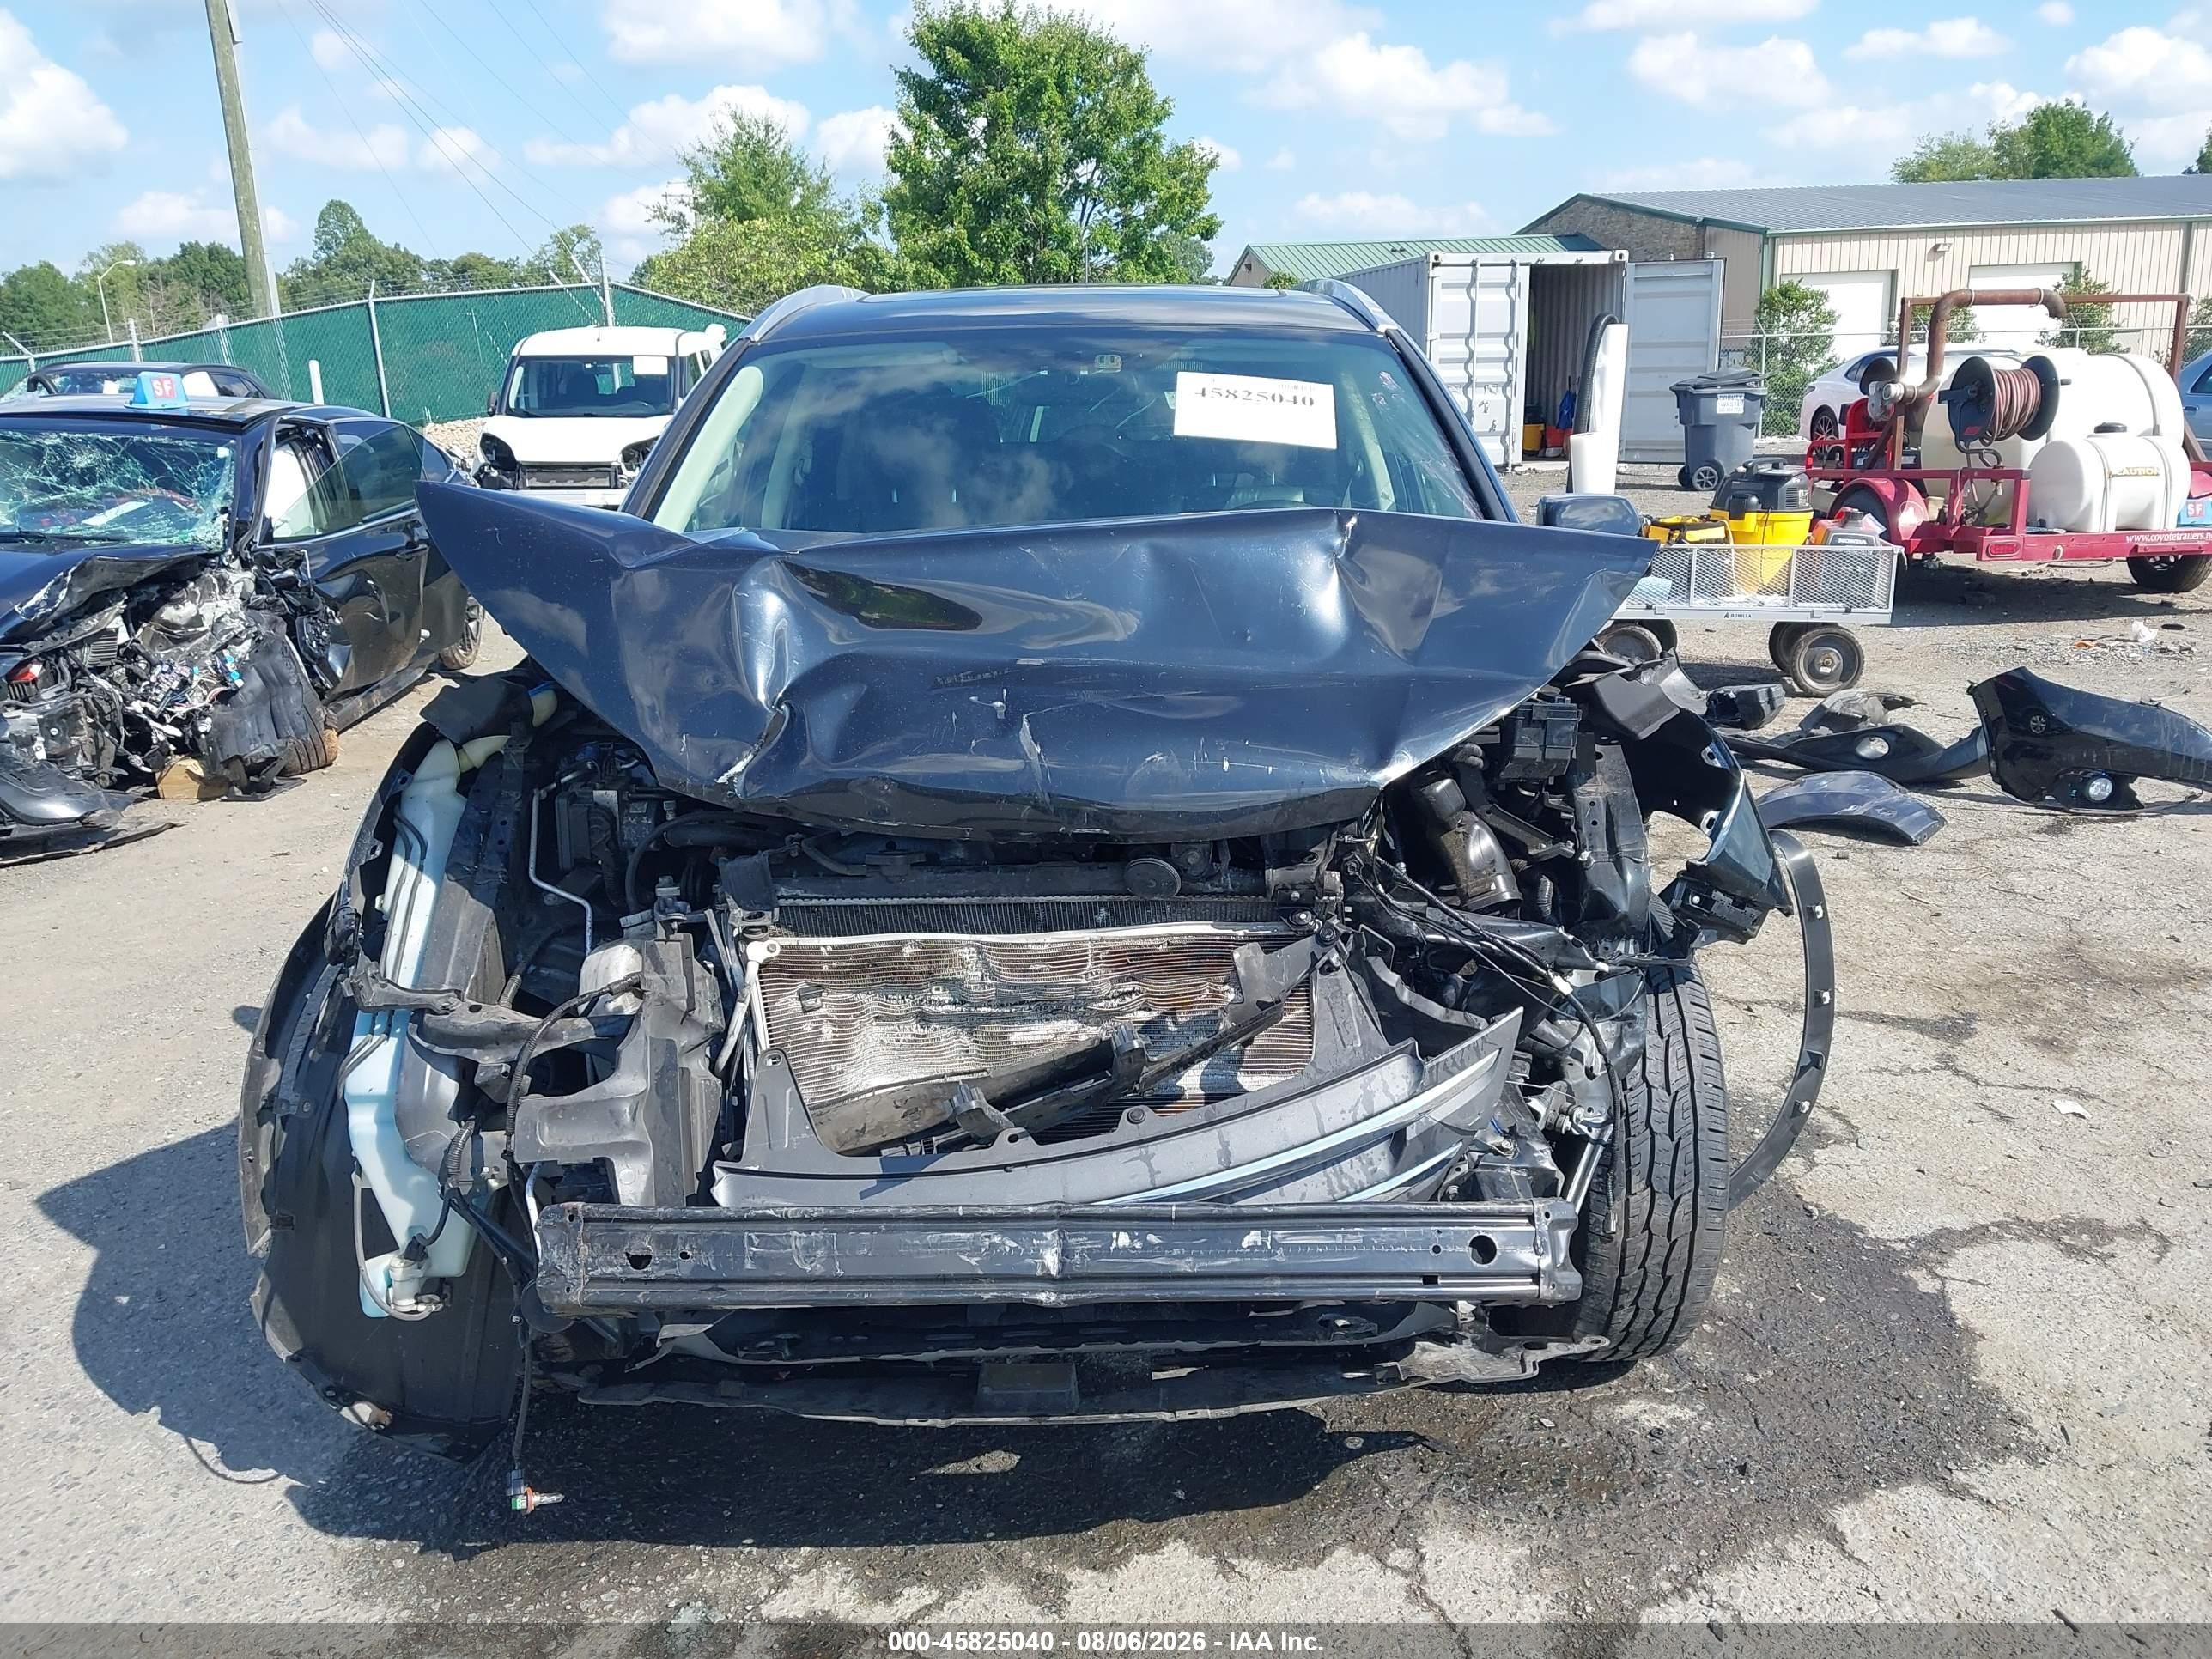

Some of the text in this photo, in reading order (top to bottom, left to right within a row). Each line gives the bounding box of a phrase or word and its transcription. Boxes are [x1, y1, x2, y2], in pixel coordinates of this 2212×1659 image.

[153, 379, 173, 398] SF
[1194, 386, 1316, 407] 45825040
[2187, 503, 2203, 516] SF
